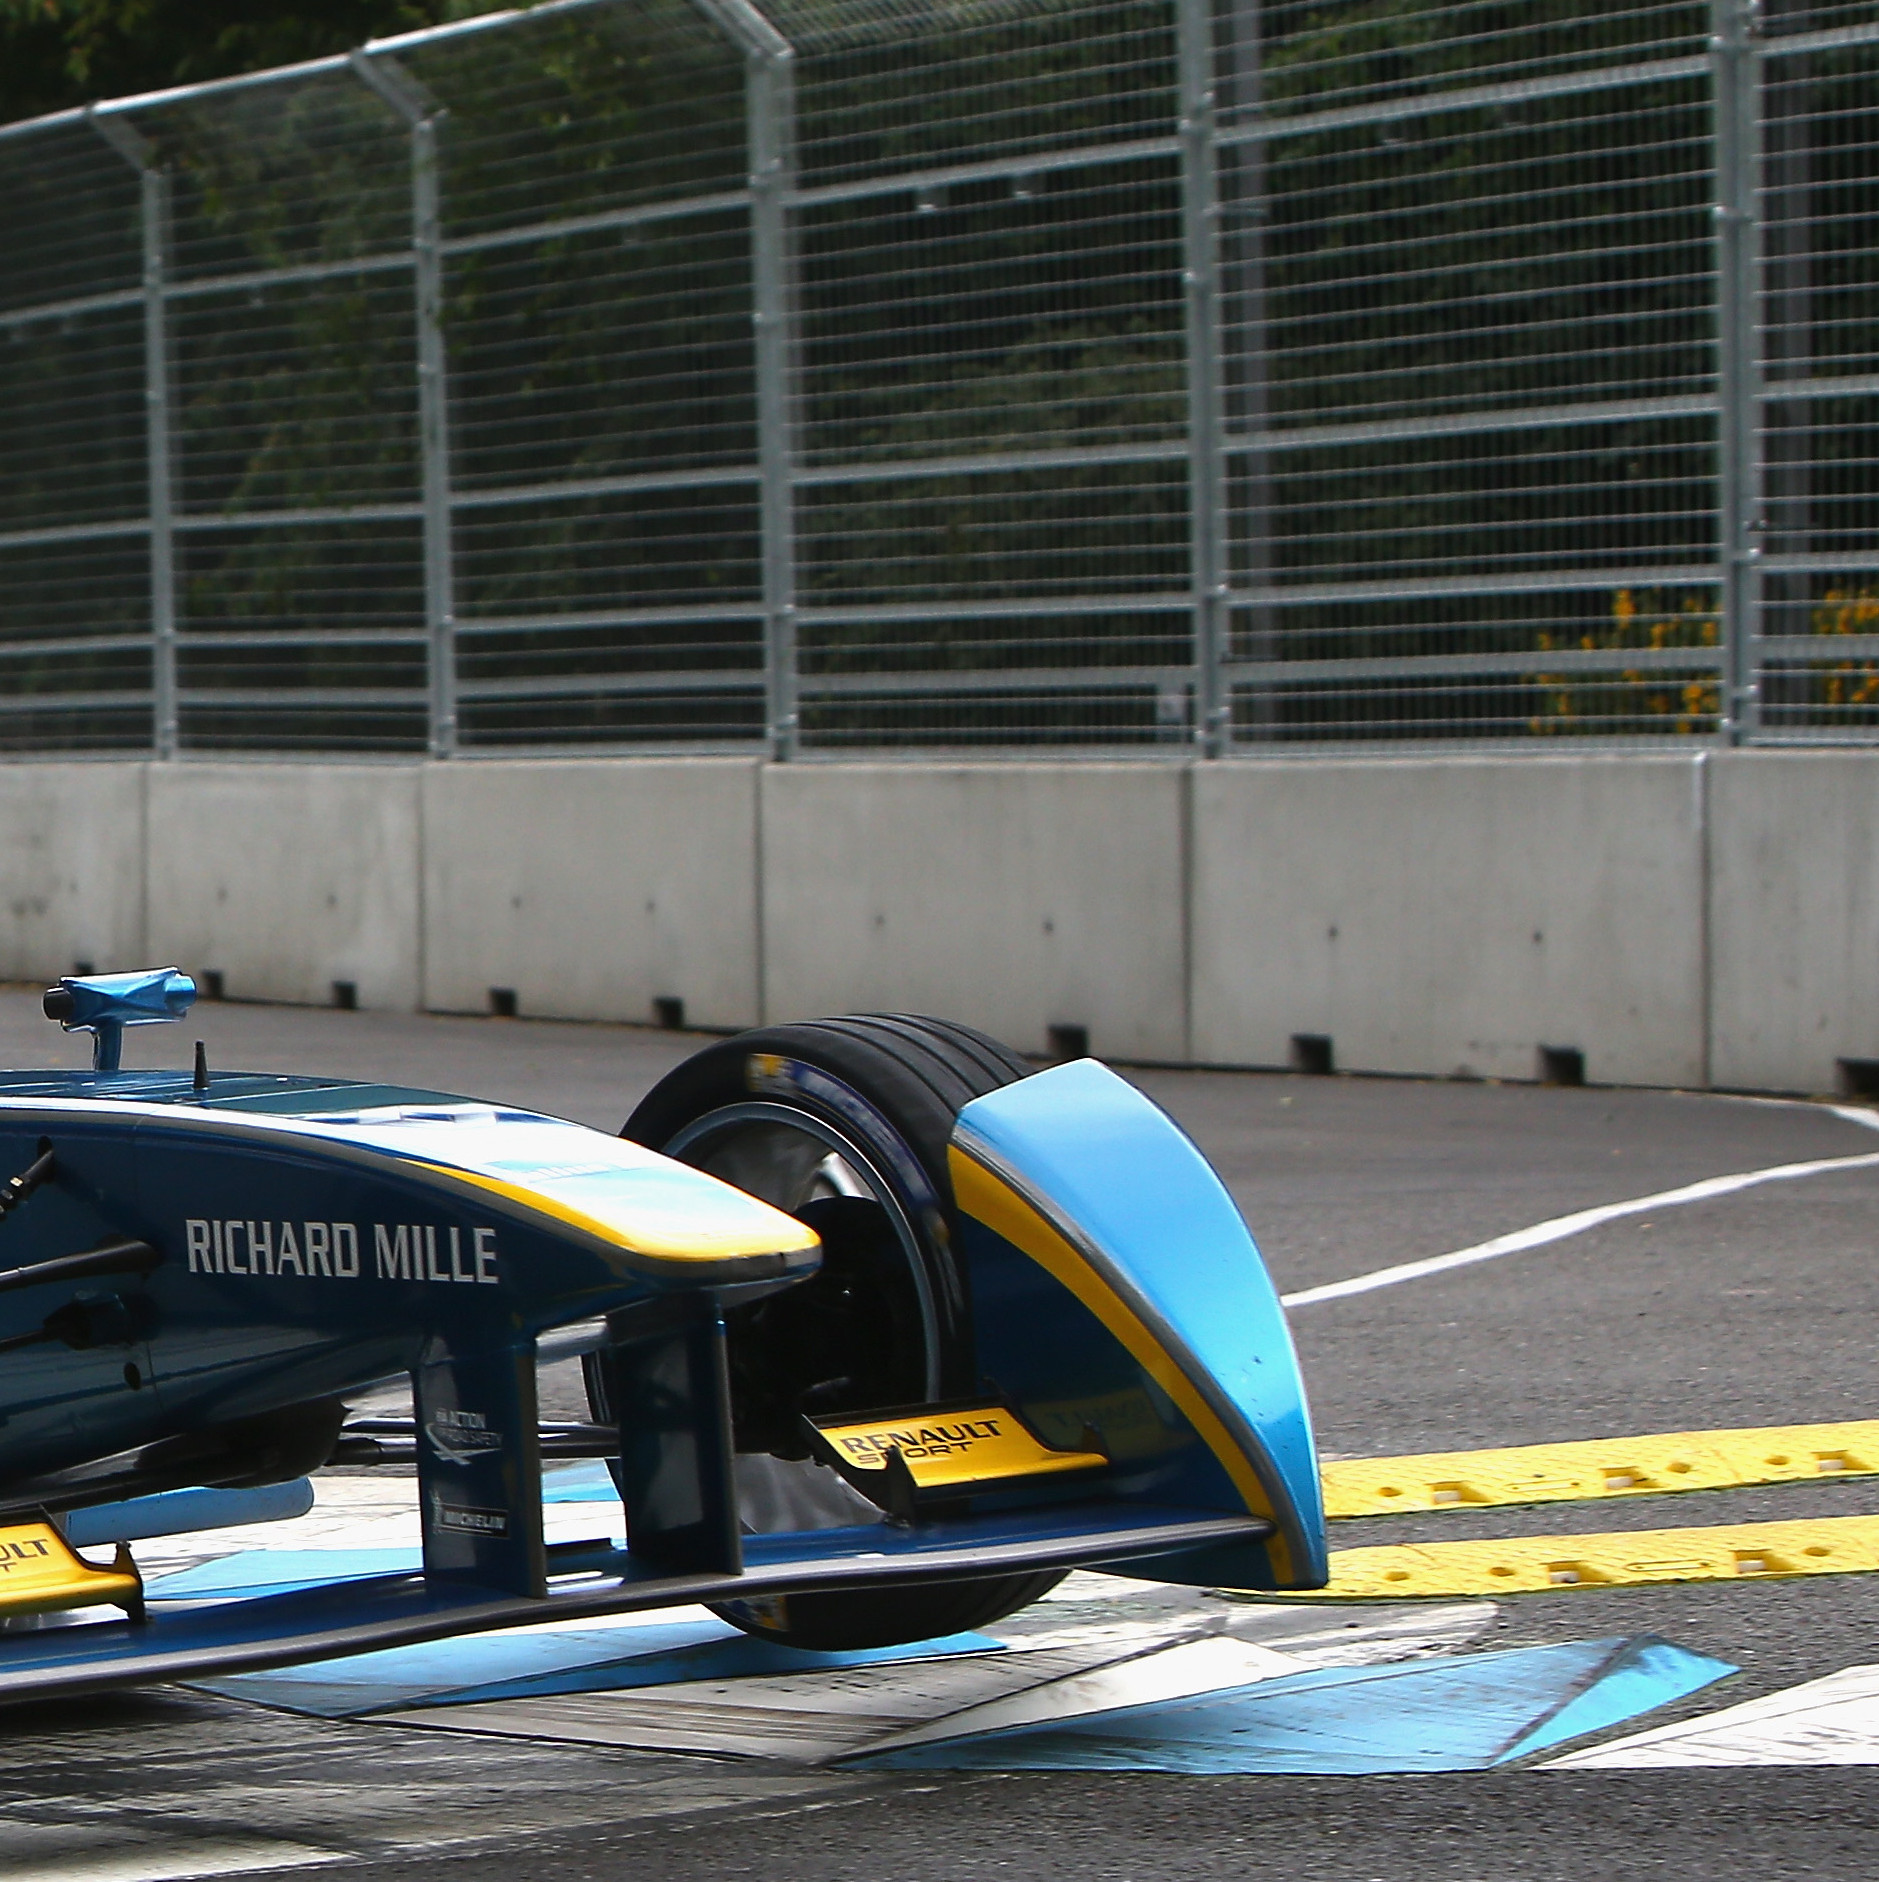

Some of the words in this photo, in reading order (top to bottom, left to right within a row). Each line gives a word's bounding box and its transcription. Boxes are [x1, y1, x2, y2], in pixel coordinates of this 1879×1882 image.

[185, 1218, 360, 1278] RICHARD
[373, 1223, 499, 1285] MILLE
[840, 1419, 1003, 1454] RENAULT
[858, 1440, 974, 1465] SORT
